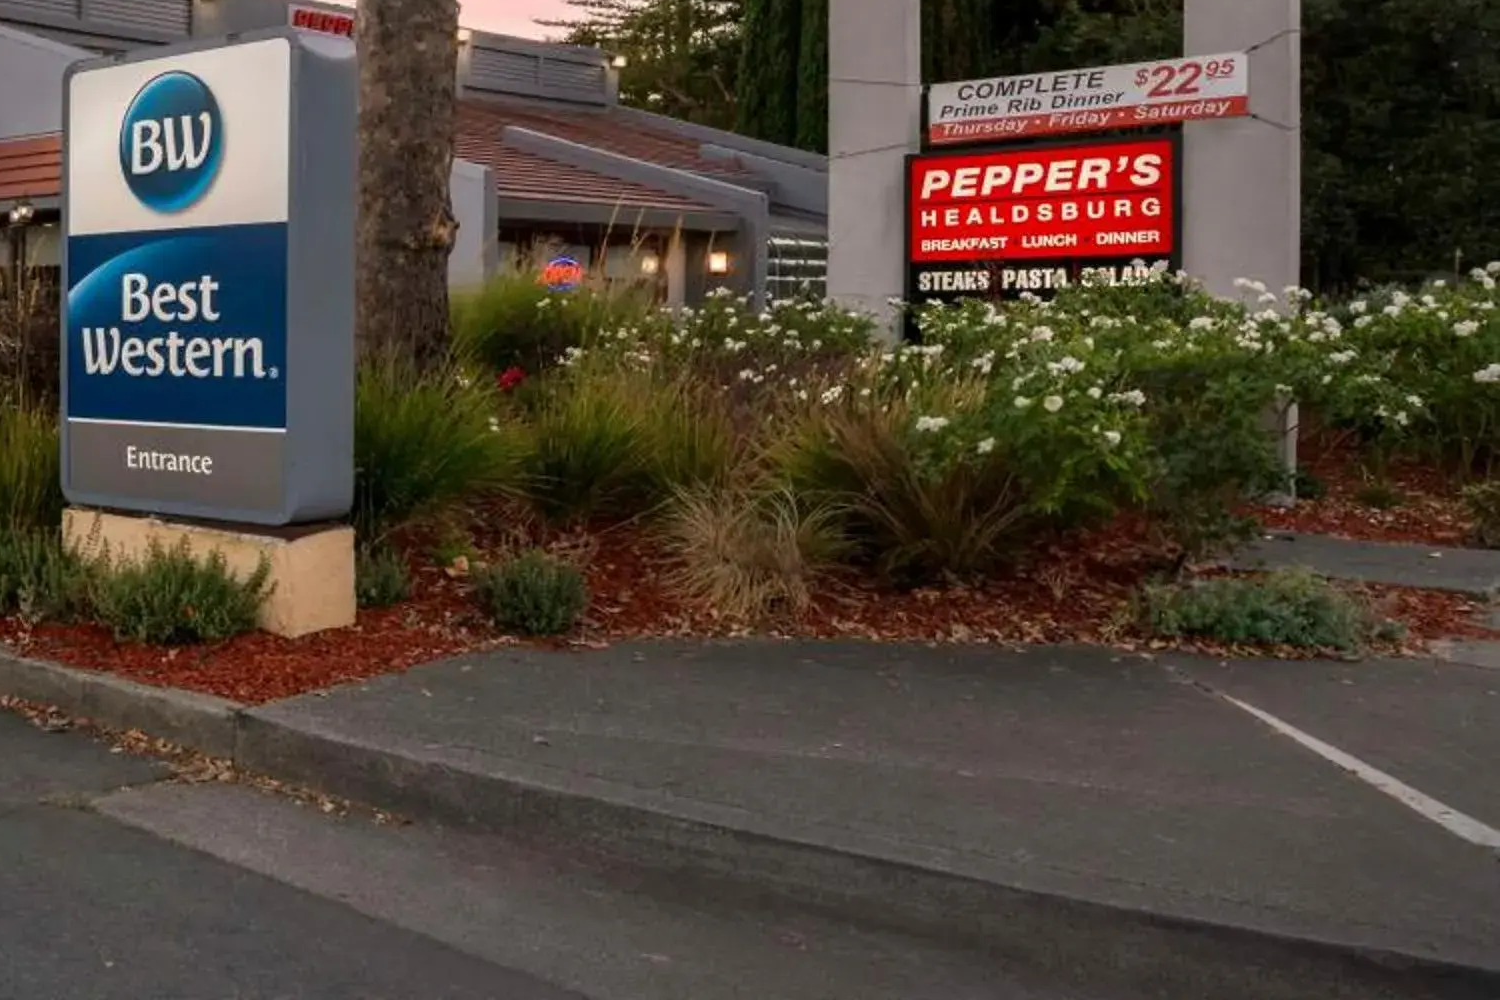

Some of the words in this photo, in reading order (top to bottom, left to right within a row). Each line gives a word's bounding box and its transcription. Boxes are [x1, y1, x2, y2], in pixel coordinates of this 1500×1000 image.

[957, 70, 1105, 101] COMPLETE
[940, 102, 999, 119] Prime
[1007, 99, 1042, 114] Rib
[1051, 89, 1124, 109] Dinner
[941, 120, 1028, 136] Thursday
[1049, 111, 1112, 128] Friday
[1134, 100, 1231, 119] Saturday
[131, 111, 212, 175] BW
[921, 154, 1161, 199] PEPPER'S
[921, 198, 1161, 227] HEALDSBURG
[921, 236, 1008, 252] BREAKFAST
[1022, 233, 1077, 249] LUNCH
[1096, 230, 1160, 246] DINNER
[919, 271, 990, 291] STEAKS
[1002, 267, 1068, 289] PASTA
[122, 273, 220, 322] Best
[126, 446, 213, 475] Entrance
